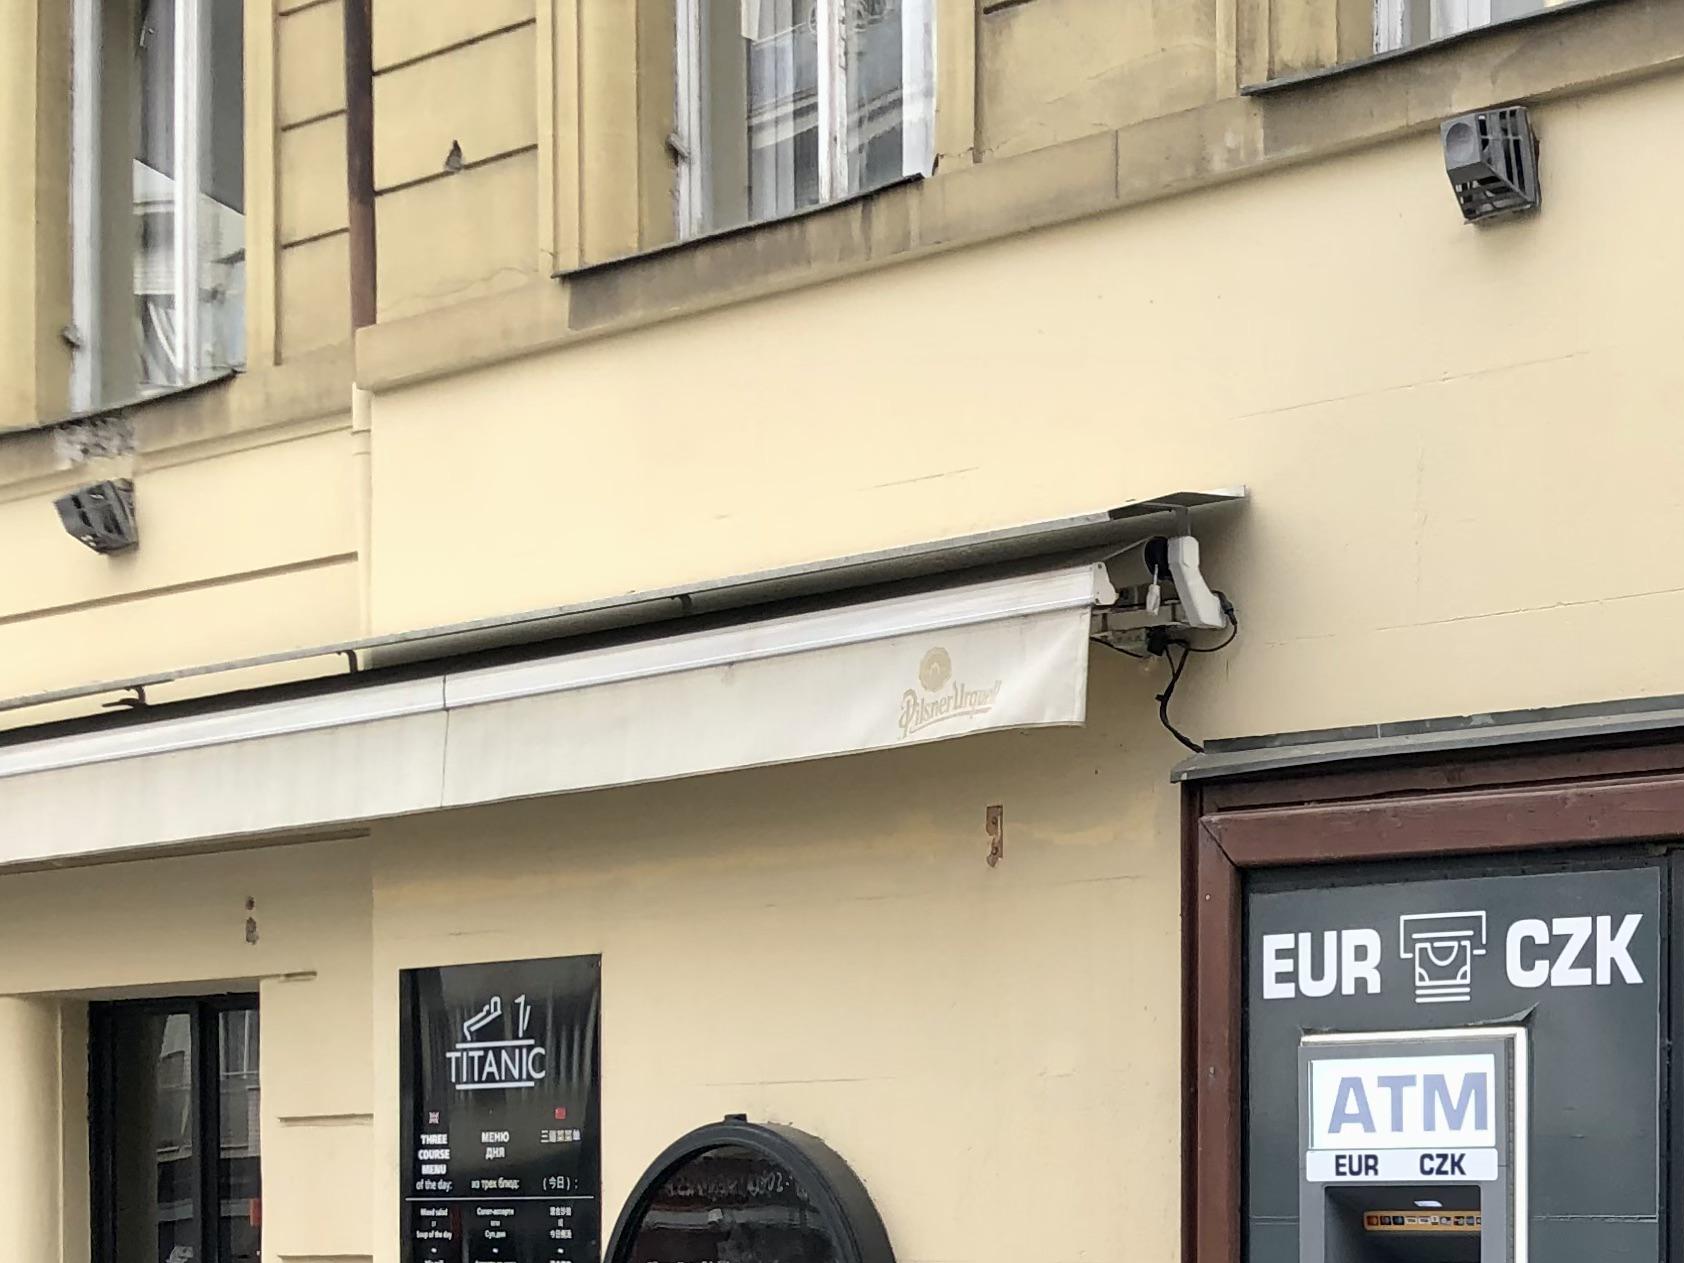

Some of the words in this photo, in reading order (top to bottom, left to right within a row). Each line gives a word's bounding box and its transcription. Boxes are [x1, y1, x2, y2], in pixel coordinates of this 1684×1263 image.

[898, 687, 954, 739] Pilsner
[1263, 928, 1382, 999] EUR
[1506, 914, 1643, 988] CZK
[446, 1047, 546, 1083] TITANIC
[1328, 1072, 1488, 1134] ATM
[420, 1134, 448, 1145] THREE
[481, 1130, 509, 1143] МЕНЮ
[417, 1149, 450, 1160] COURSE
[485, 1147, 505, 1160] ДНЯ
[421, 1164, 447, 1175] MENU
[1335, 1154, 1379, 1176] EUR
[1419, 1153, 1466, 1176] CZK
[416, 1179, 424, 1189] of
[425, 1179, 437, 1189] the
